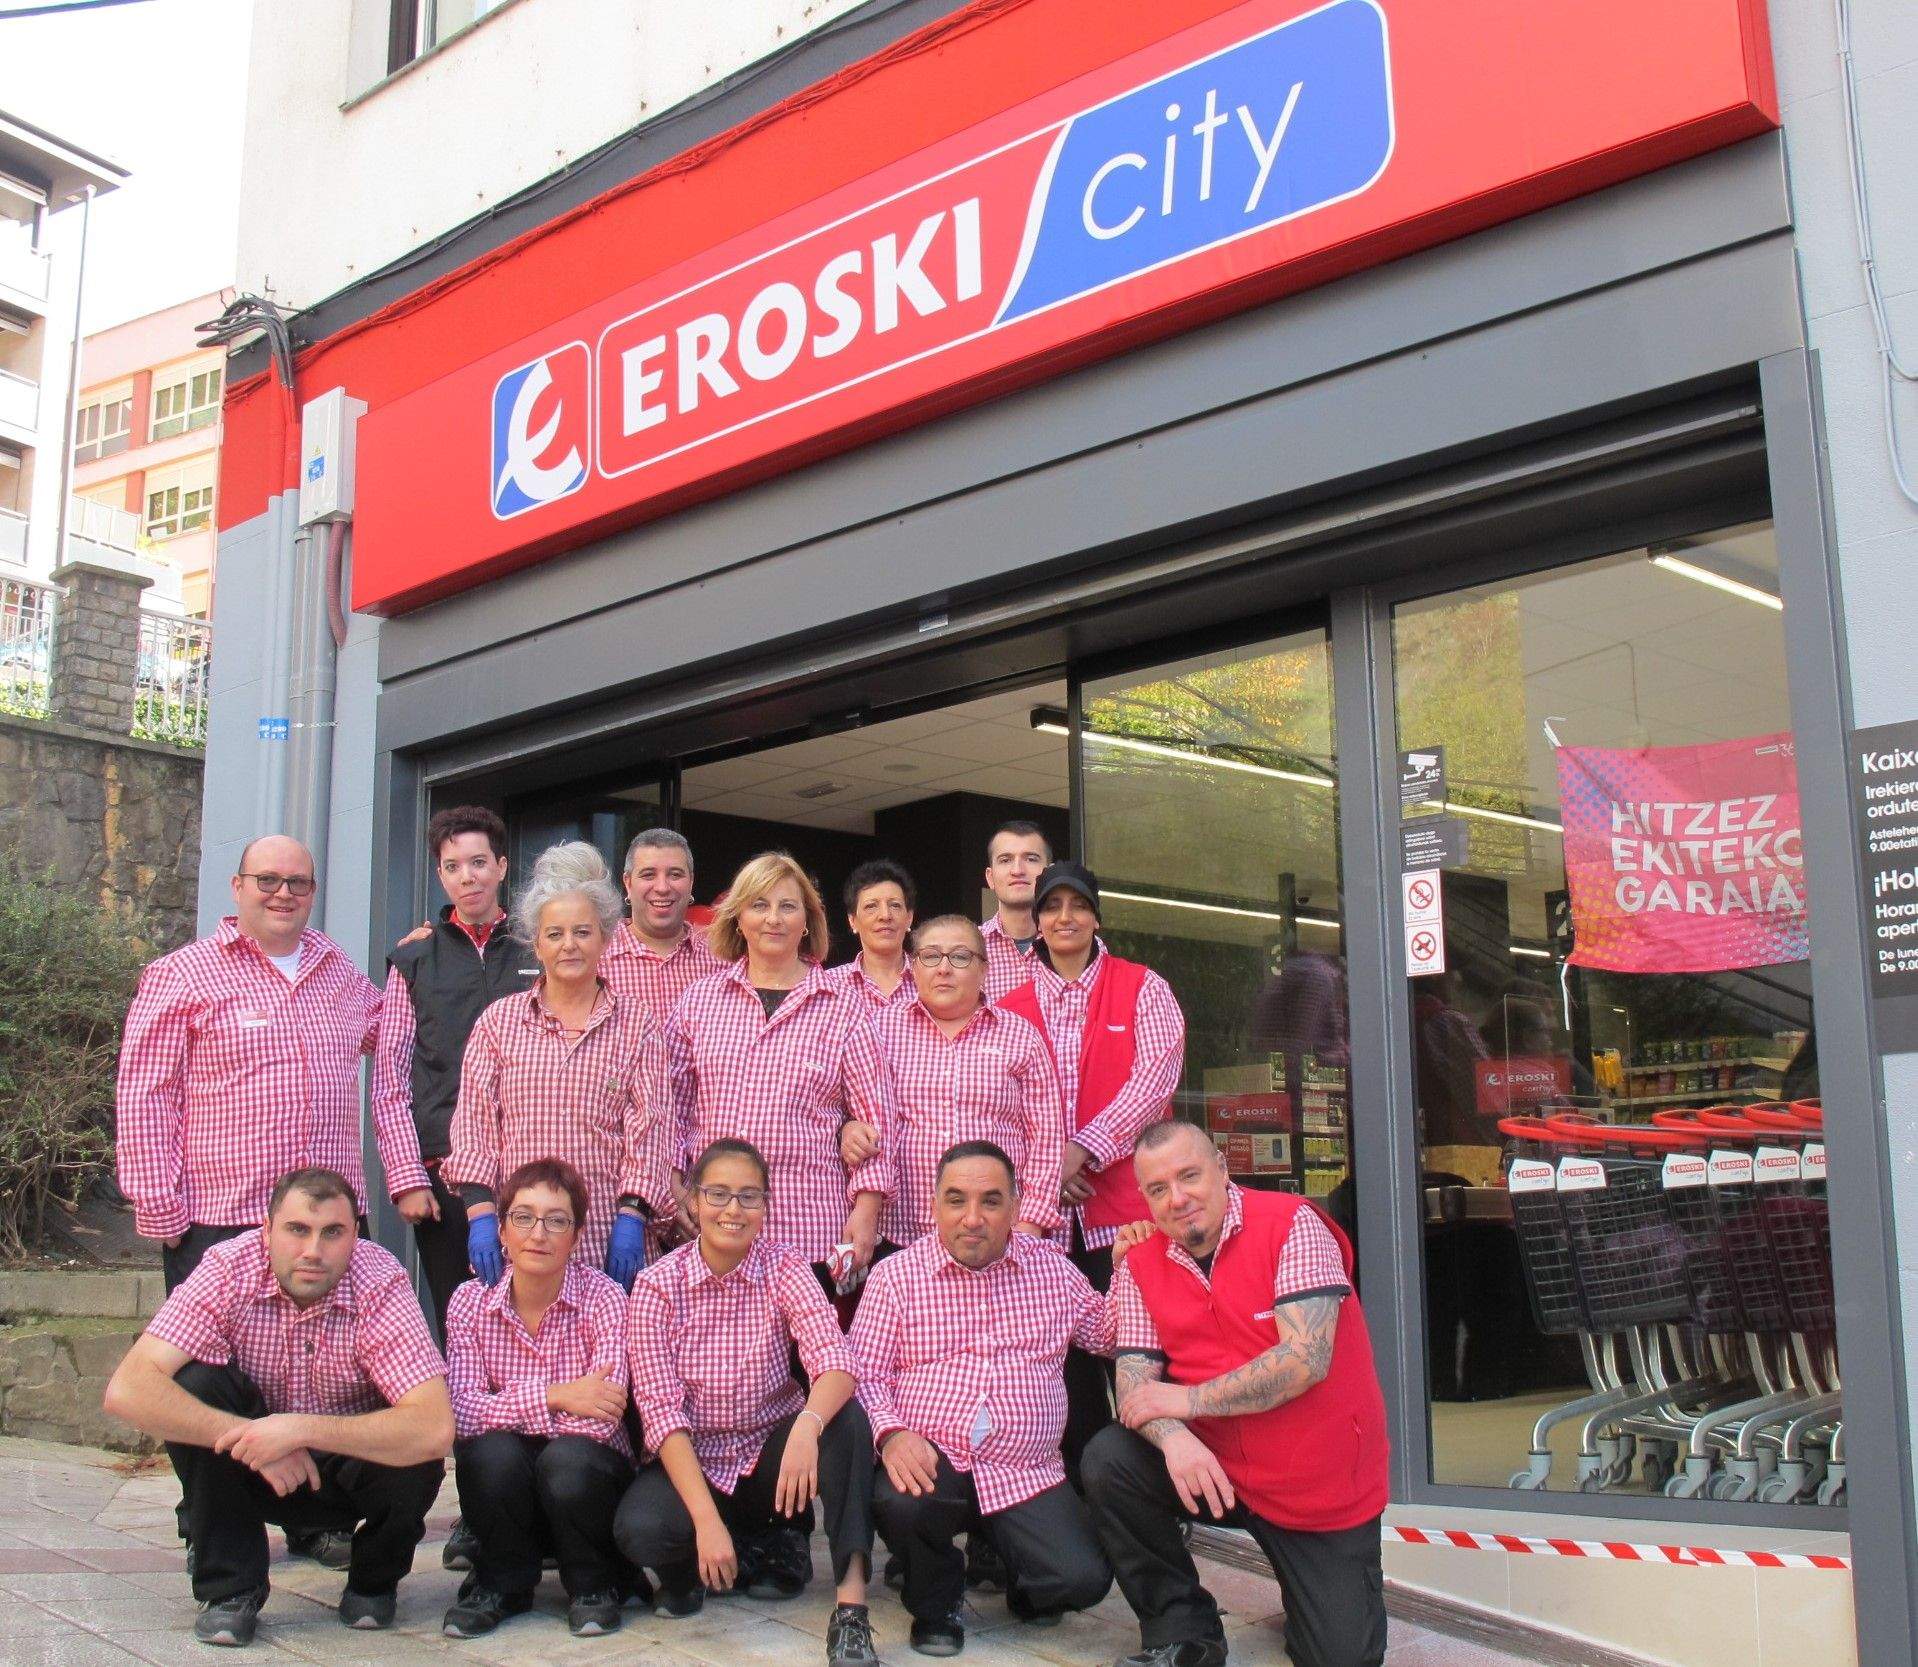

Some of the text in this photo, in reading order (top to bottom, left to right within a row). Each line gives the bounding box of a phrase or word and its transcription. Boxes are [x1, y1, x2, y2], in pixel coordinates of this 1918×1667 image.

[621, 198, 982, 437] EROSKI
[1082, 81, 1304, 239] city
[1862, 748, 1918, 774] Kaix
[1611, 794, 1777, 836] HITZEZ
[1615, 873, 1803, 915] GARAIA
[1878, 950, 1895, 961] De
[1880, 962, 1896, 973] De
[1508, 1072, 1555, 1083] EROSKI
[1236, 1107, 1278, 1117] EROSKI
[1522, 1168, 1550, 1178] EROSKI
[1570, 1167, 1599, 1177] EROSKI
[1676, 1163, 1704, 1173] EROSKI
